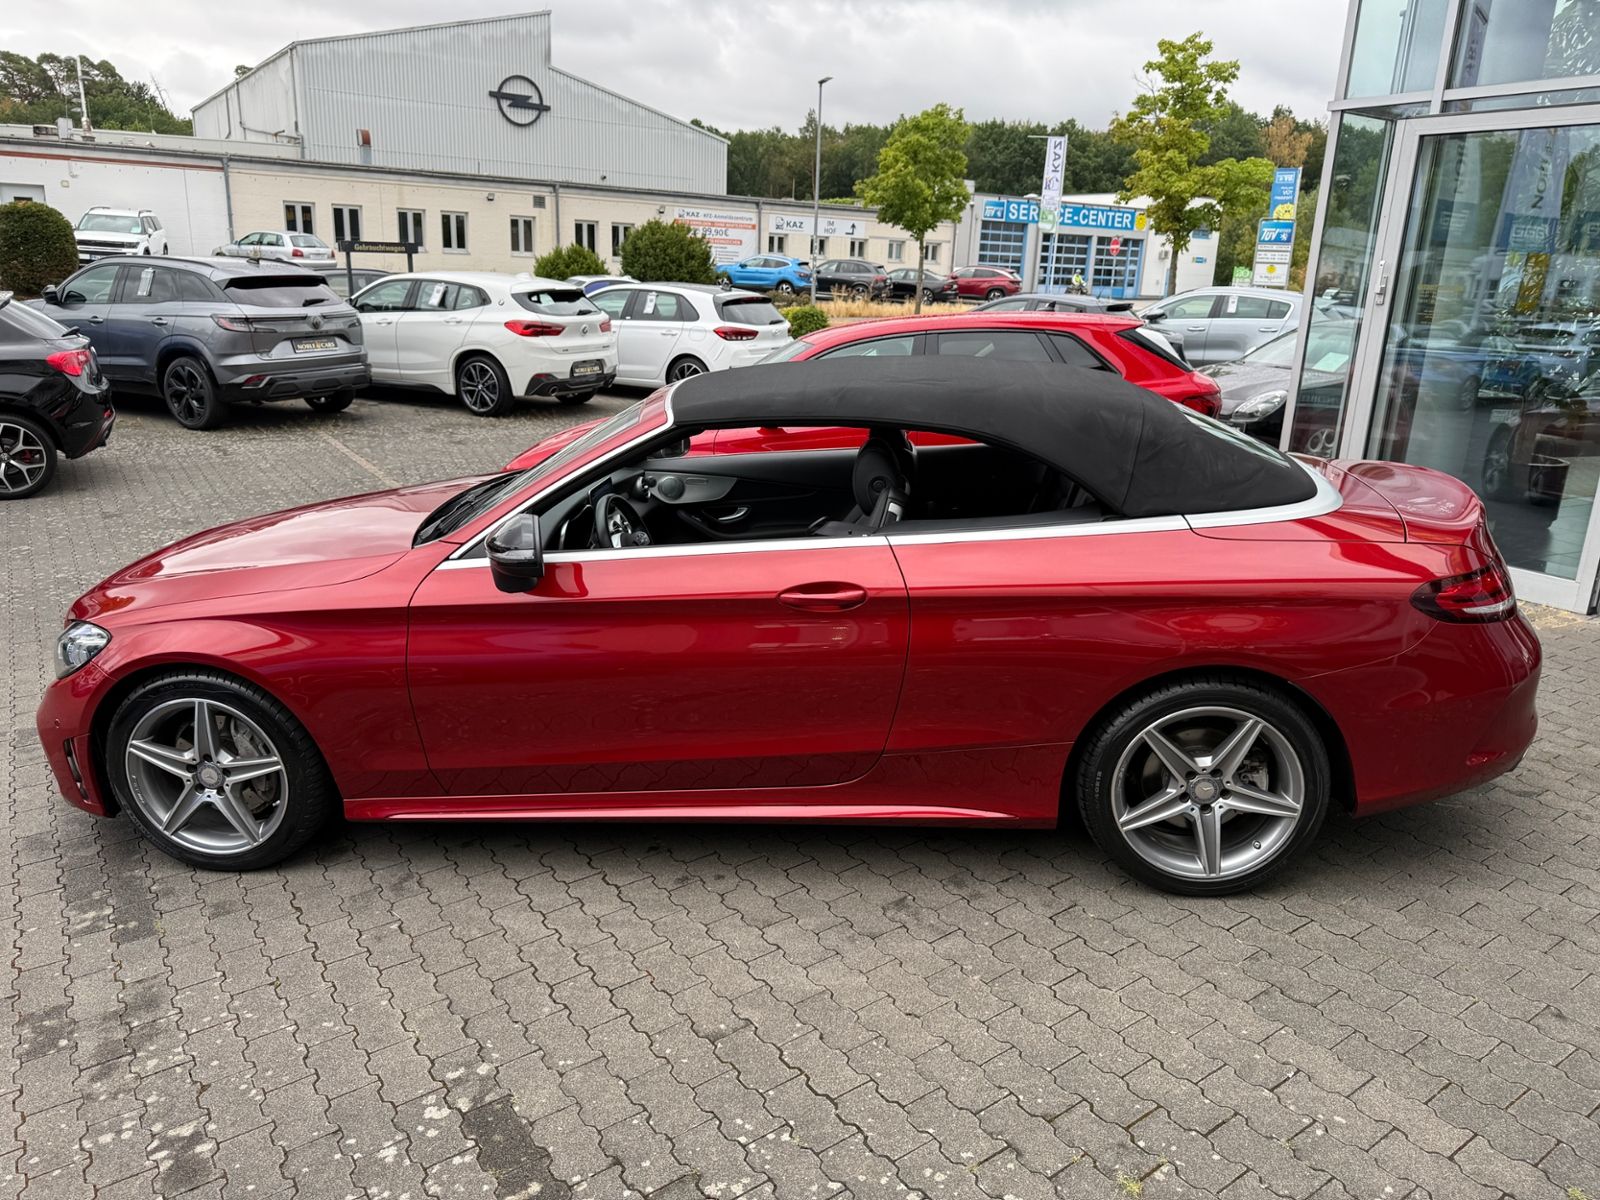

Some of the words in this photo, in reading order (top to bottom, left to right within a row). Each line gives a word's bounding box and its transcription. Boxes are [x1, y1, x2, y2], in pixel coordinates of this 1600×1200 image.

[1009, 203, 1132, 229] SERCE-CENTER
[786, 220, 804, 229] KAZ
[824, 227, 836, 235] HOF
